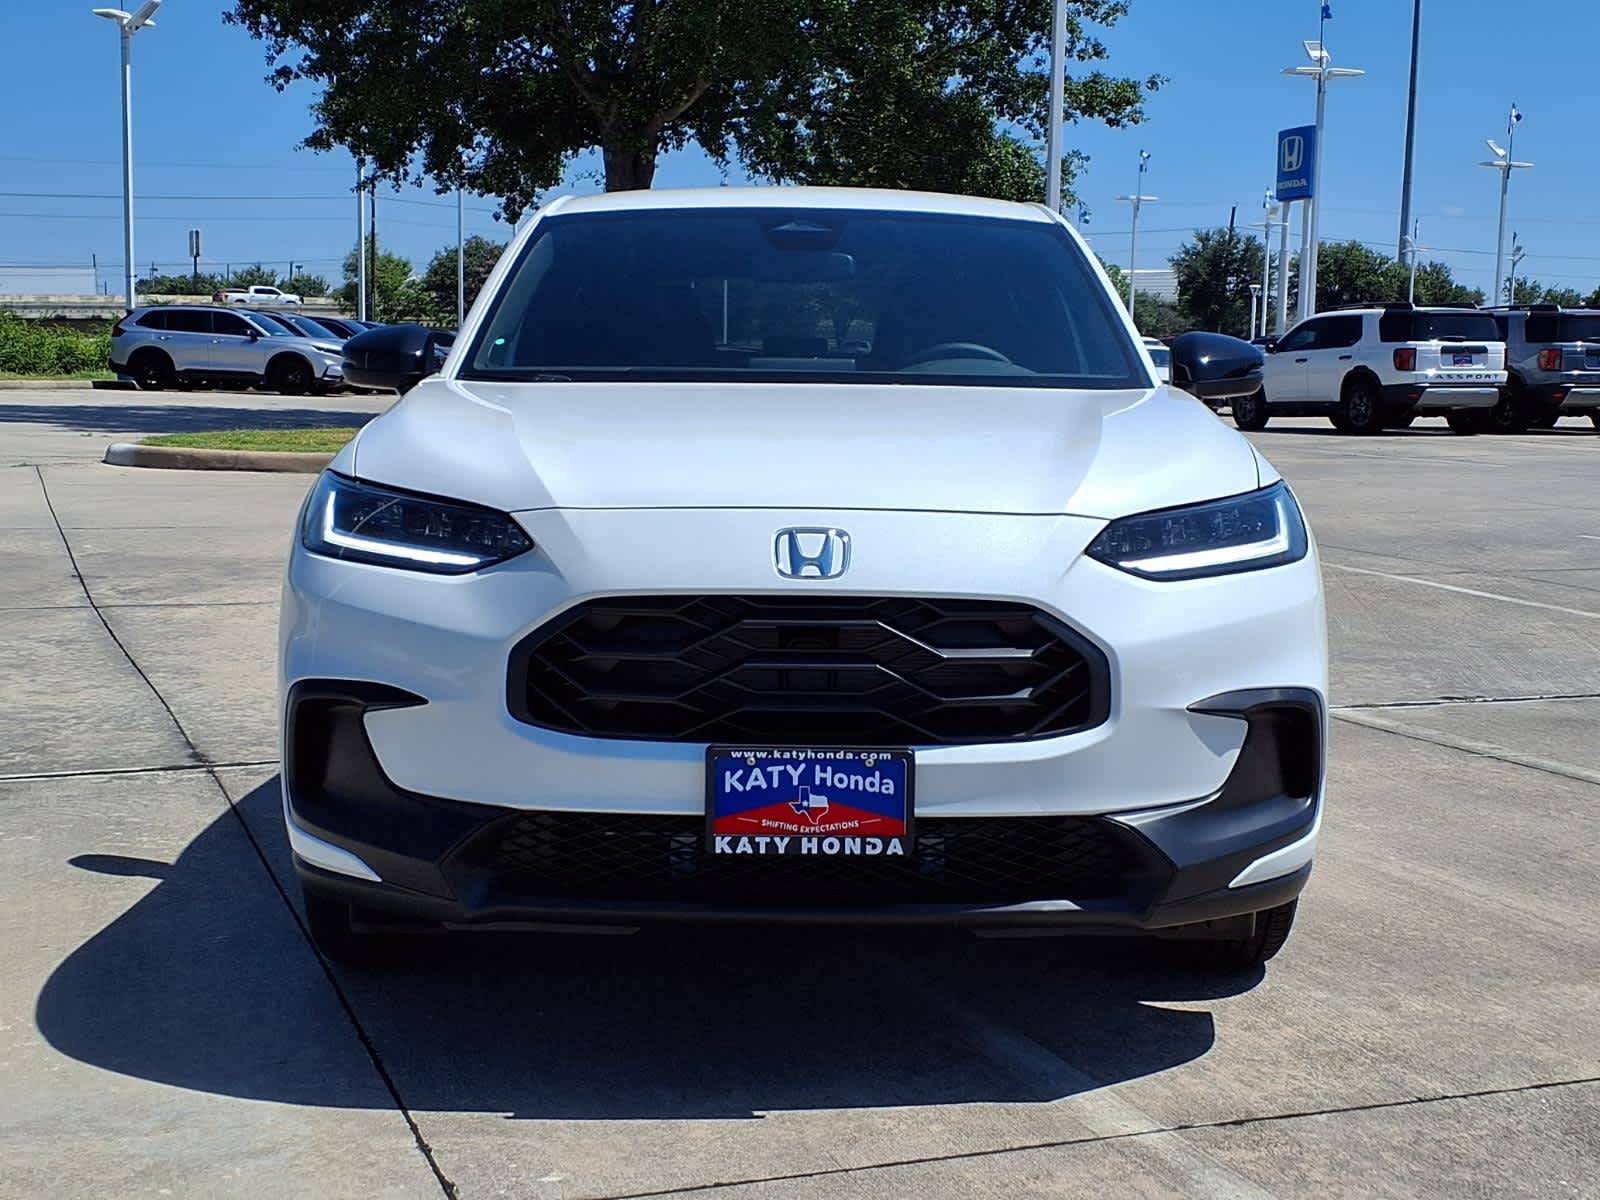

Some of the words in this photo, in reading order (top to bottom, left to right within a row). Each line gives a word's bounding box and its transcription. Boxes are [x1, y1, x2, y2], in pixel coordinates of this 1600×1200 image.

[731, 750, 892, 761] www.katyhonda.com
[724, 763, 806, 793] KATY
[815, 764, 895, 795] Honda
[761, 818, 798, 832] SHIFTING
[799, 820, 860, 833] EXPECTATIONS
[715, 836, 790, 855] KATY
[801, 837, 904, 856] HONDA
